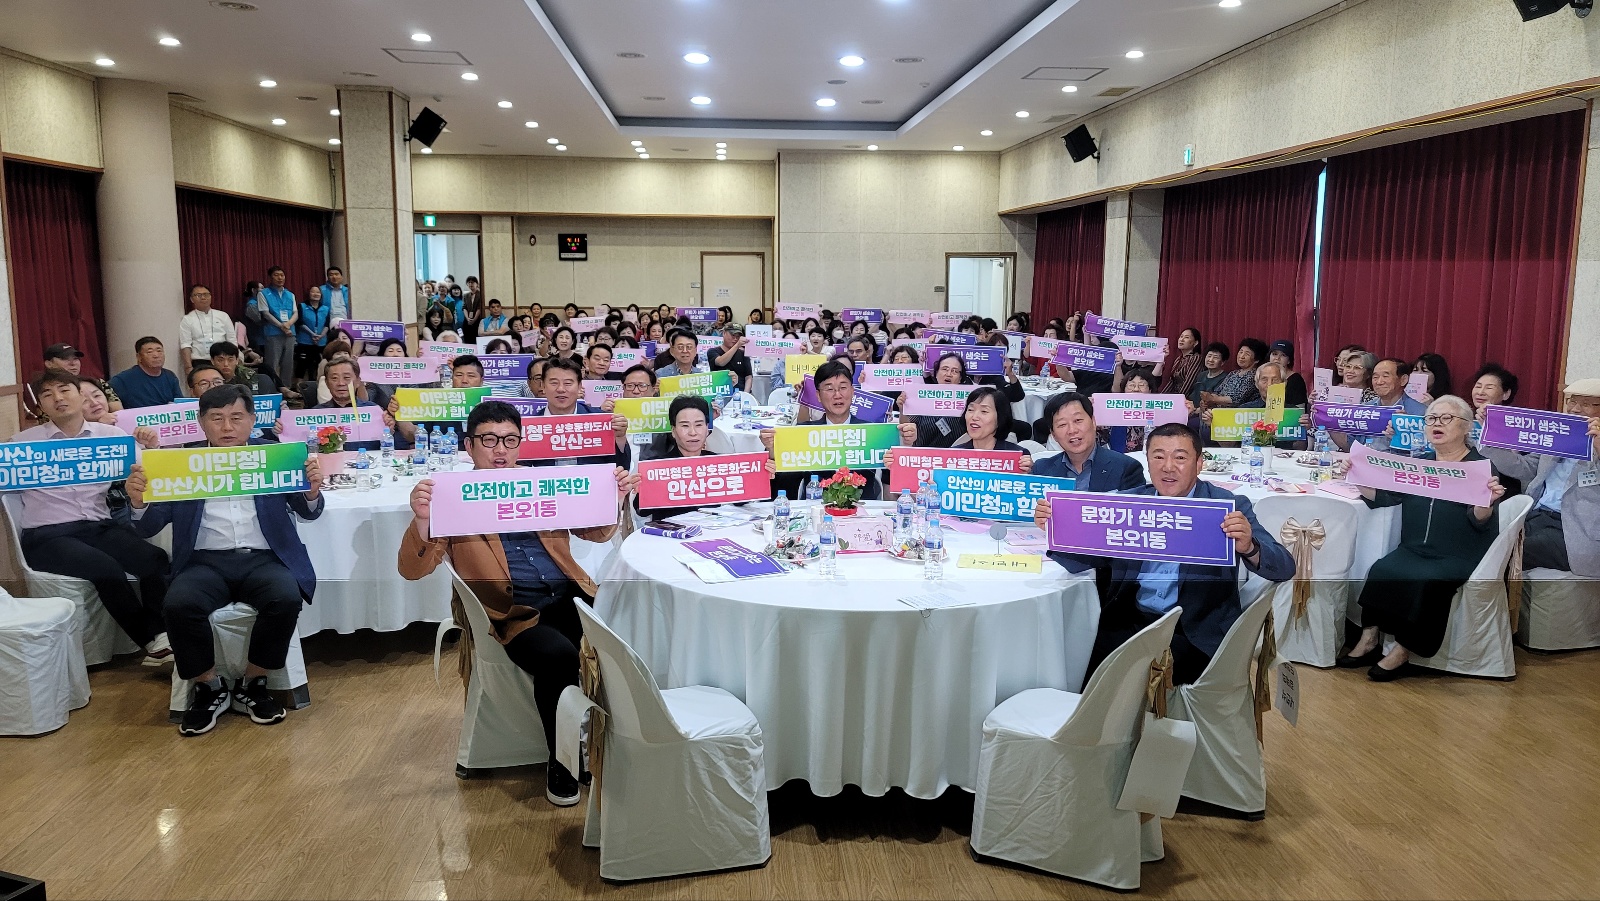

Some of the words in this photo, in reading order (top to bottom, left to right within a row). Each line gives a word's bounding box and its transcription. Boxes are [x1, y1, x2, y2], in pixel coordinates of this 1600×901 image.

[369, 362, 401, 370] 안전하고
[403, 362, 427, 370] 쾌적한
[874, 368, 902, 377] 안전하고
[385, 371, 412, 379] 본오1동
[420, 392, 467, 404] 이민청!
[918, 390, 953, 399] 안전하고
[400, 406, 447, 419] 안산시가
[1106, 400, 1143, 410] 안전하고
[1145, 400, 1173, 410] 쾌적한
[136, 412, 182, 427] 안전하고
[295, 415, 337, 426] 안전하고
[1123, 410, 1155, 420] 본오1동
[1327, 408, 1352, 418] 문화가
[1353, 410, 1380, 420] 샘솟는
[160, 423, 198, 438] 본오1동
[555, 422, 612, 434] 상호문화도시
[1338, 419, 1368, 430] 본오1동
[1505, 415, 1536, 431] 문화가
[1538, 420, 1571, 436] 샘솟는
[550, 434, 602, 451] 안산으로
[808, 428, 867, 448] 이민청!
[1518, 430, 1554, 447] 본오1동
[50, 447, 93, 462] 새로운
[95, 444, 128, 459] 도전!
[188, 450, 267, 473] 이민청!
[781, 450, 842, 468] 안산시가
[646, 464, 693, 482] 이민청은
[695, 460, 761, 480] 상호문화도시
[899, 455, 943, 469] 이민청은
[946, 457, 1014, 471] 상호문화도시
[1366, 456, 1419, 473] 안전하고
[1423, 465, 1466, 479] 쾌적한
[0, 464, 75, 486] 이민청과
[77, 459, 124, 480] 함께!
[1393, 471, 1441, 489] 본오1동
[151, 474, 235, 497] 안산시가
[240, 470, 303, 490] 합니다!
[461, 481, 533, 501] 안전하고
[538, 478, 590, 496] 쾌적한
[667, 476, 745, 500] 안산으로
[948, 476, 984, 492] 안산의
[987, 479, 1026, 494] 새로운
[497, 500, 557, 520] 본오1동
[941, 491, 1014, 516] 이민청과
[1081, 505, 1133, 527] 문화가
[1138, 509, 1193, 530] 샘솟는
[1105, 528, 1167, 549] 본오1동
